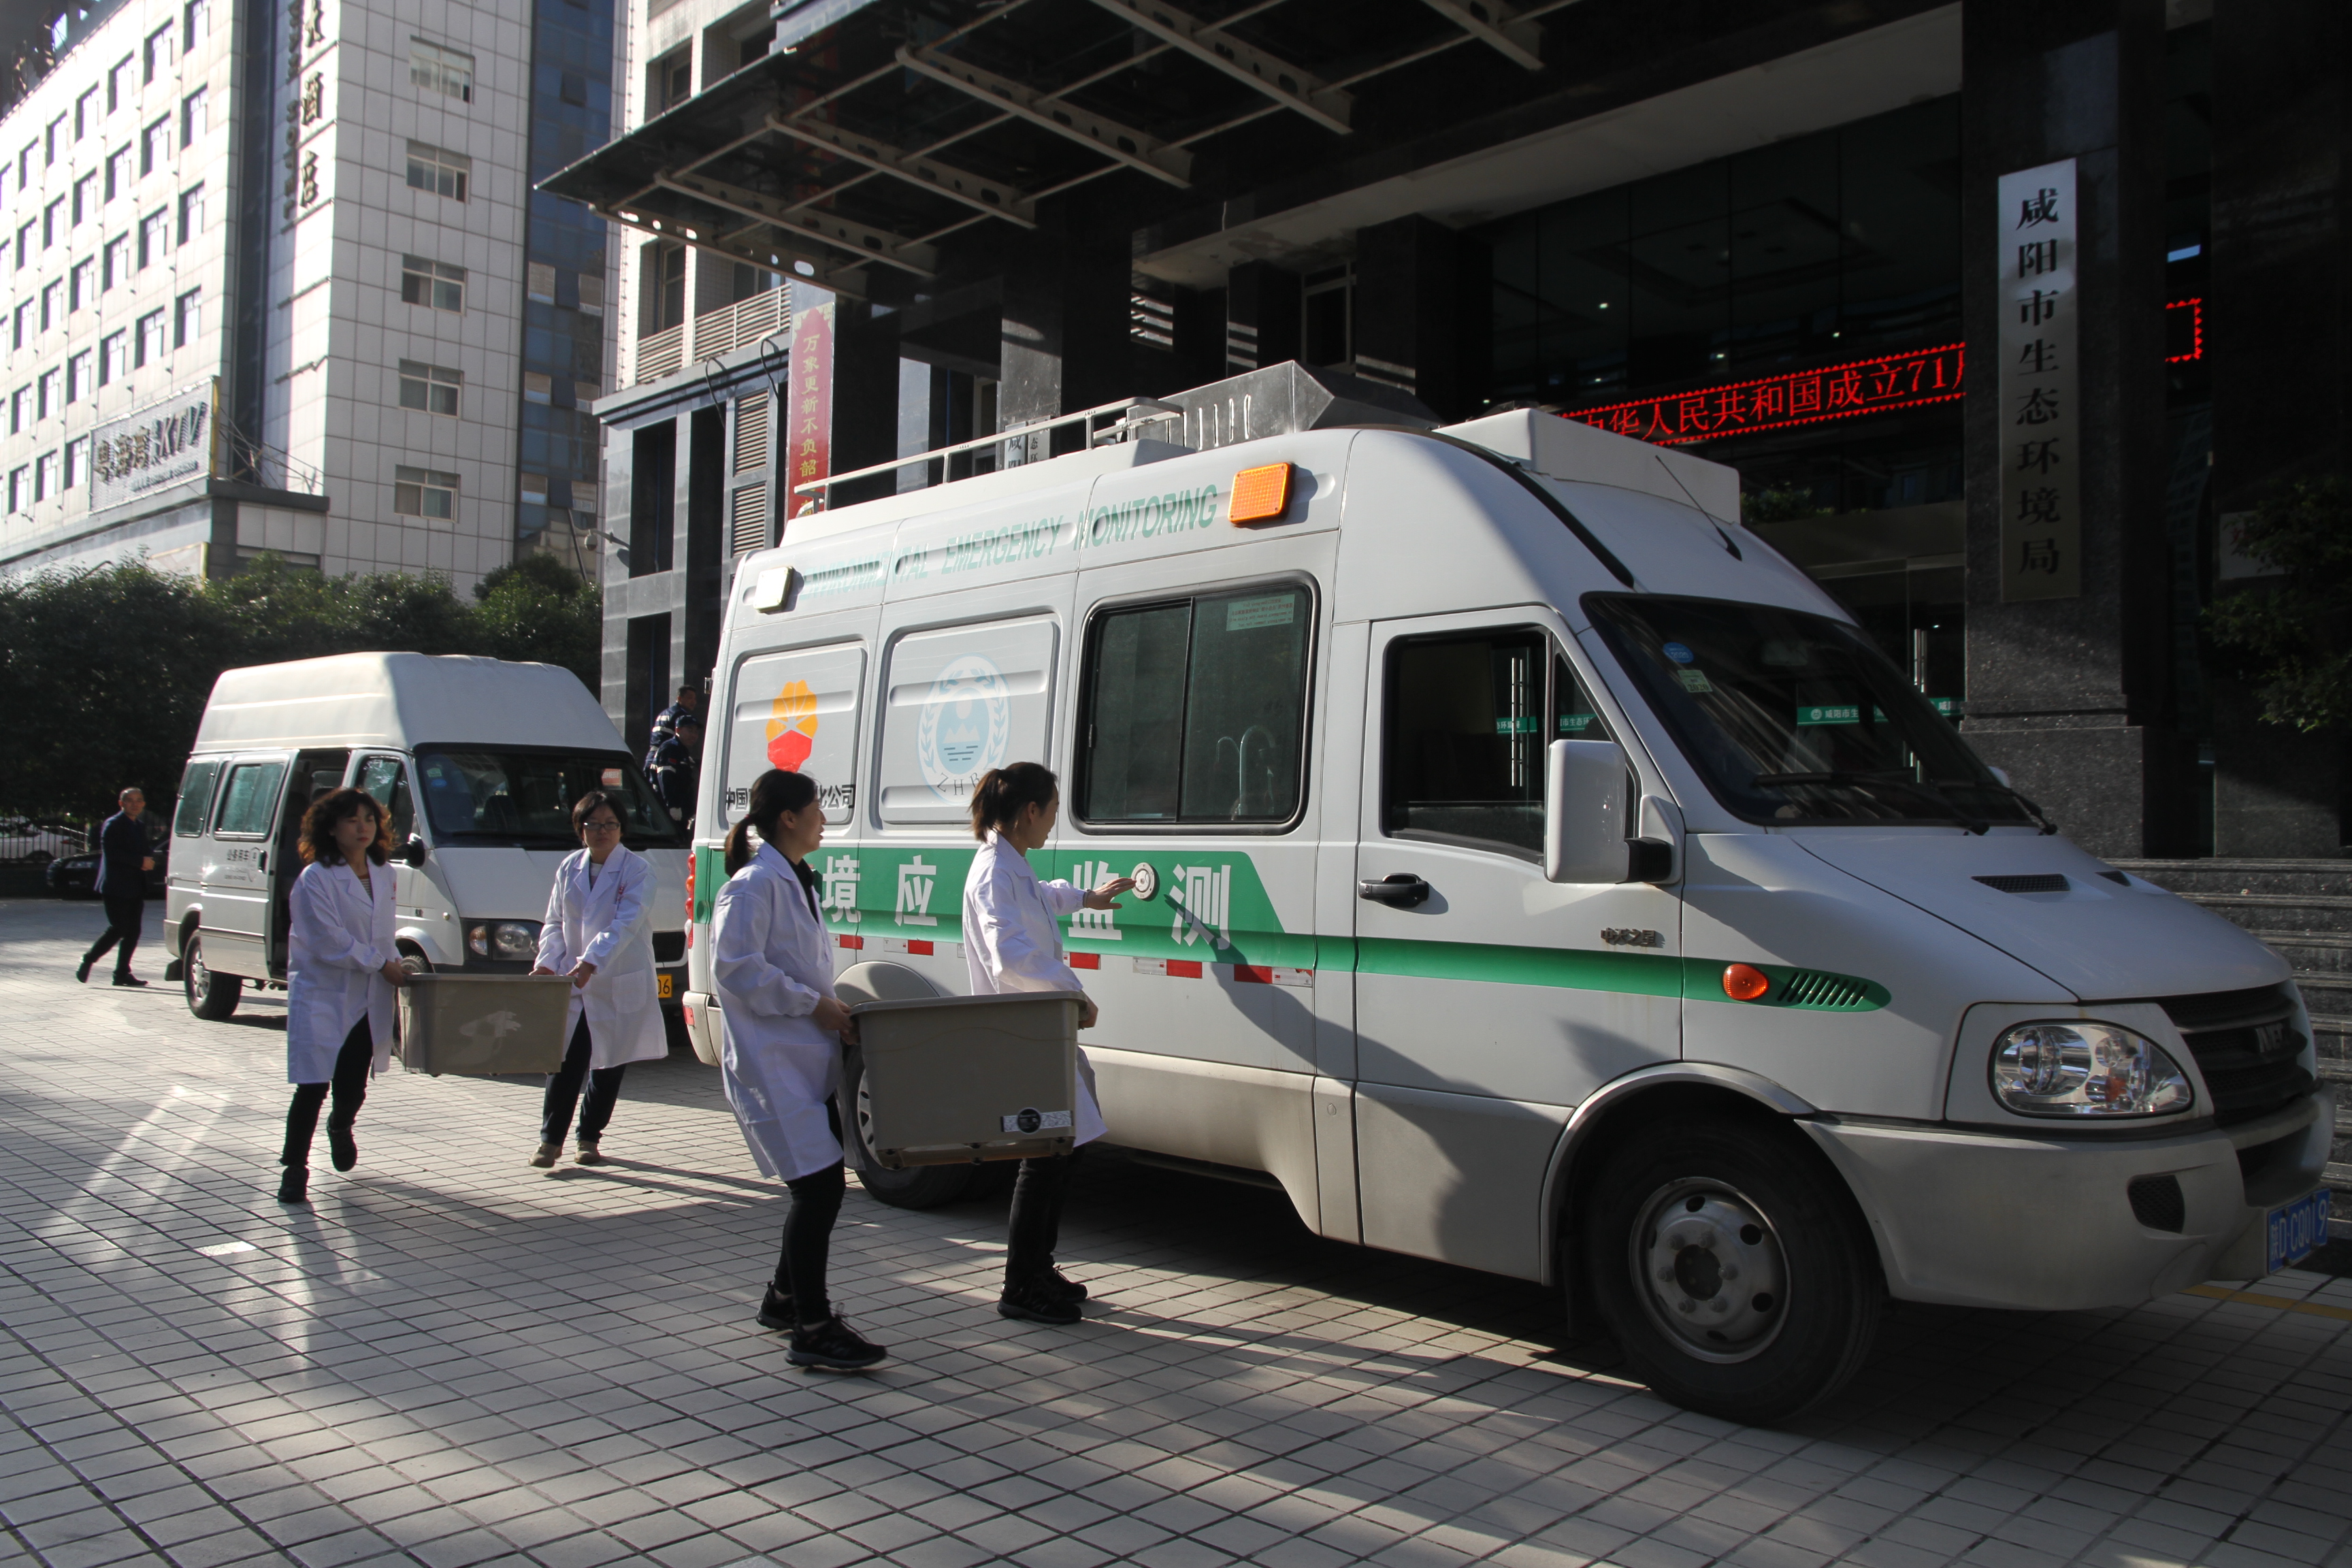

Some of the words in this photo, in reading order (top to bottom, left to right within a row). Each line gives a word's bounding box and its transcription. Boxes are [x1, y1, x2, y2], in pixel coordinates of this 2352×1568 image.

[800, 334, 820, 515] 万象更新不负韶
[2016, 188, 2061, 576] 咸阳市生态环境局
[799, 543, 930, 601] ENVIRONMENTAL
[941, 514, 1064, 575] EMERGENCY
[1073, 484, 1218, 551] MONITORING
[1601, 927, 1656, 946] 中天之星
